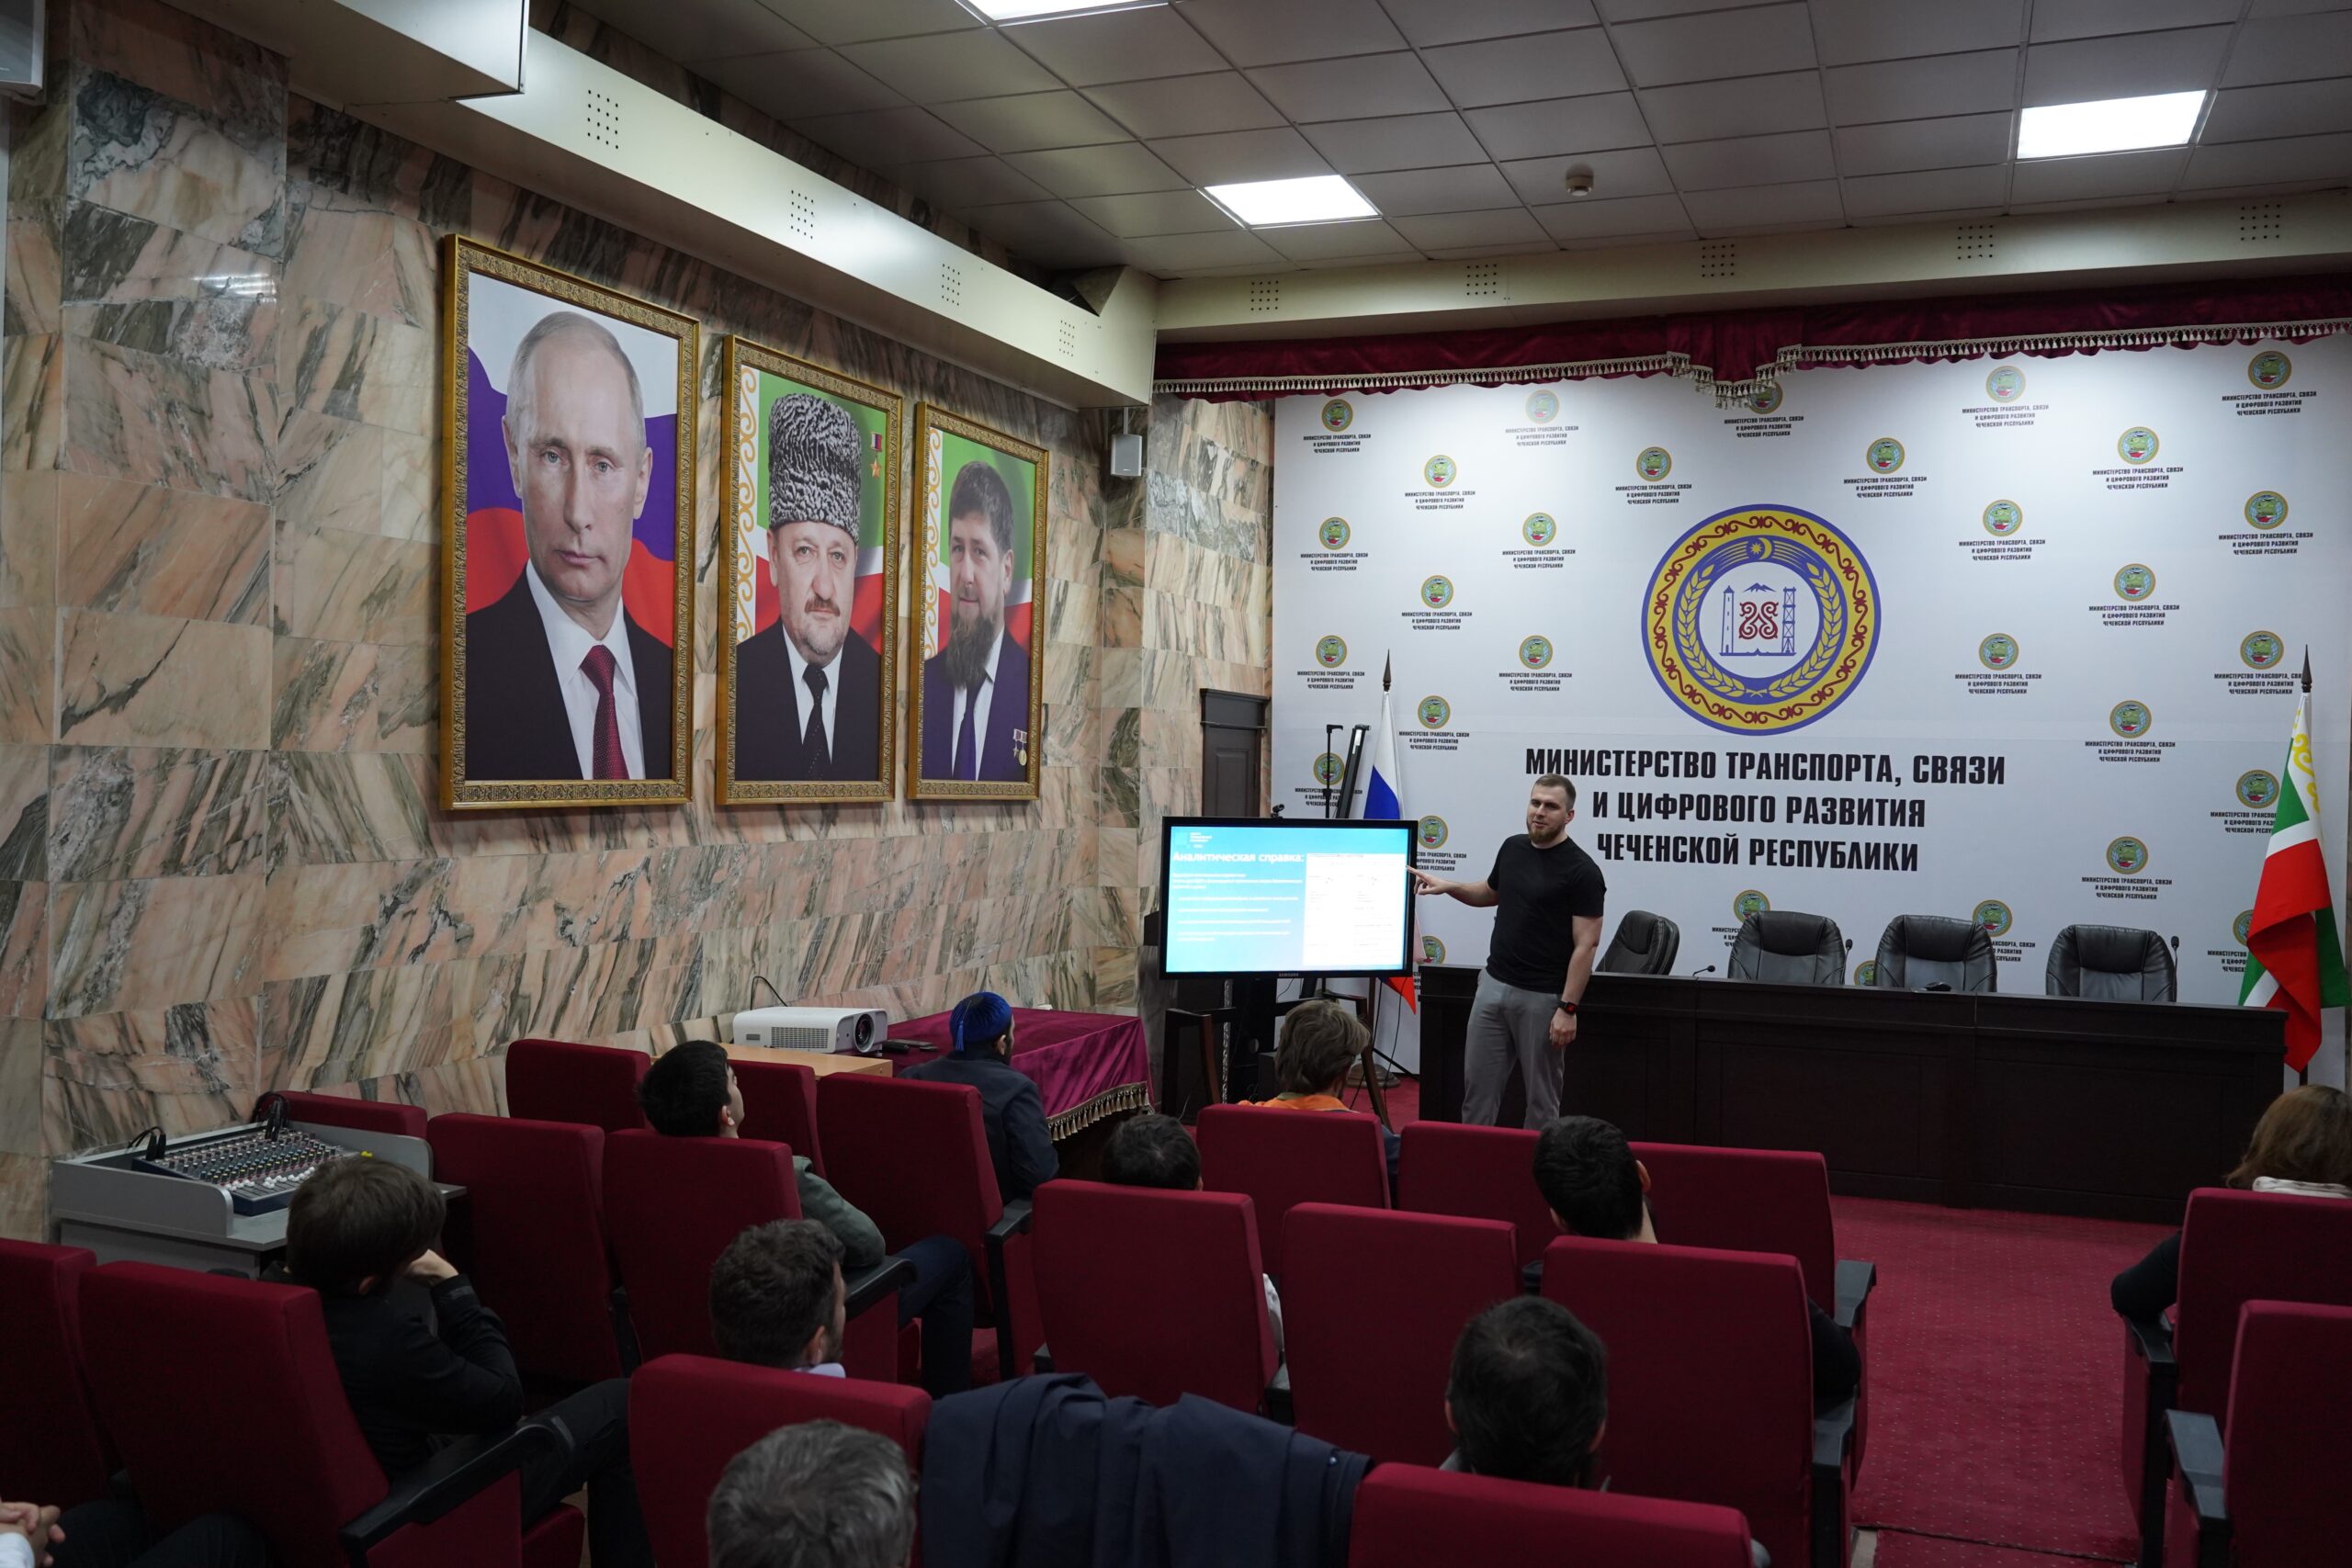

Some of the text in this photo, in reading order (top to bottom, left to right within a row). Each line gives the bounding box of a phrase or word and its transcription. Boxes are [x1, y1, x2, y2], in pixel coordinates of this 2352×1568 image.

[1525, 748, 2005, 787] МИНИСТЕРСТВО ТРАНСПОРТА, СВЯЗИ
[1592, 791, 1926, 828] И ЦИФРОВОГО РАЗВИТИЯ
[1597, 832, 1918, 872] ЧЕЧЕНСКОЙ РЕСПУБЛИКИ
